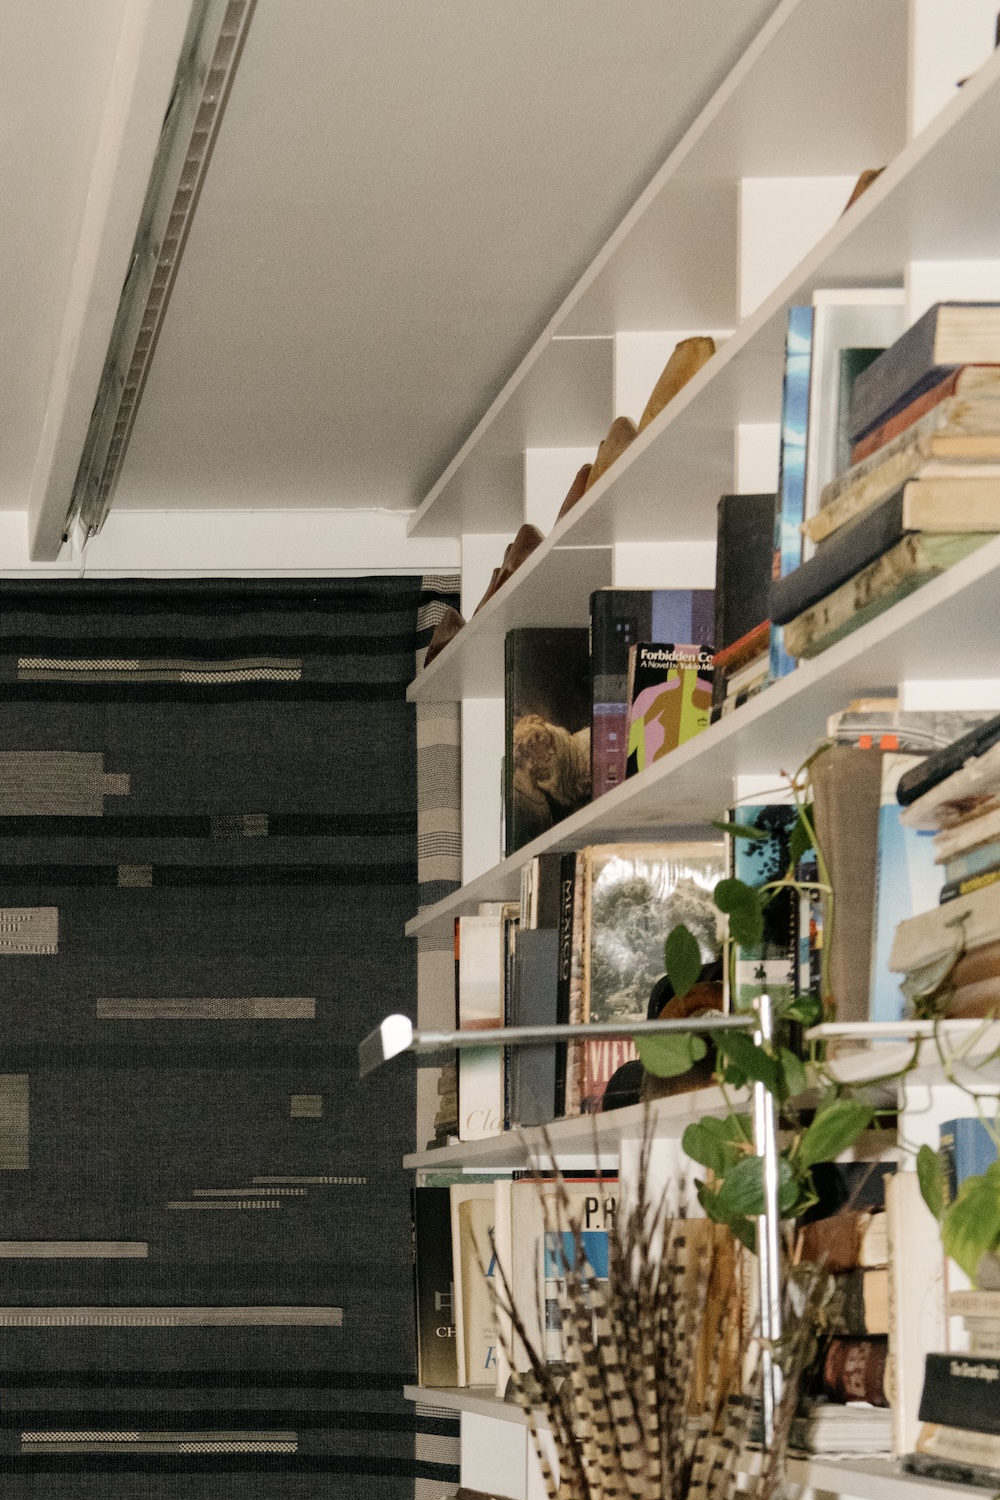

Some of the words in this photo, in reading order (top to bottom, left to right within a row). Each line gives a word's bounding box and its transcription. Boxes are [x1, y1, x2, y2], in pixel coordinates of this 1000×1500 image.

[641, 649, 695, 662] Forbidden
[640, 660, 648, 668] A
[648, 660, 669, 669] Novel
